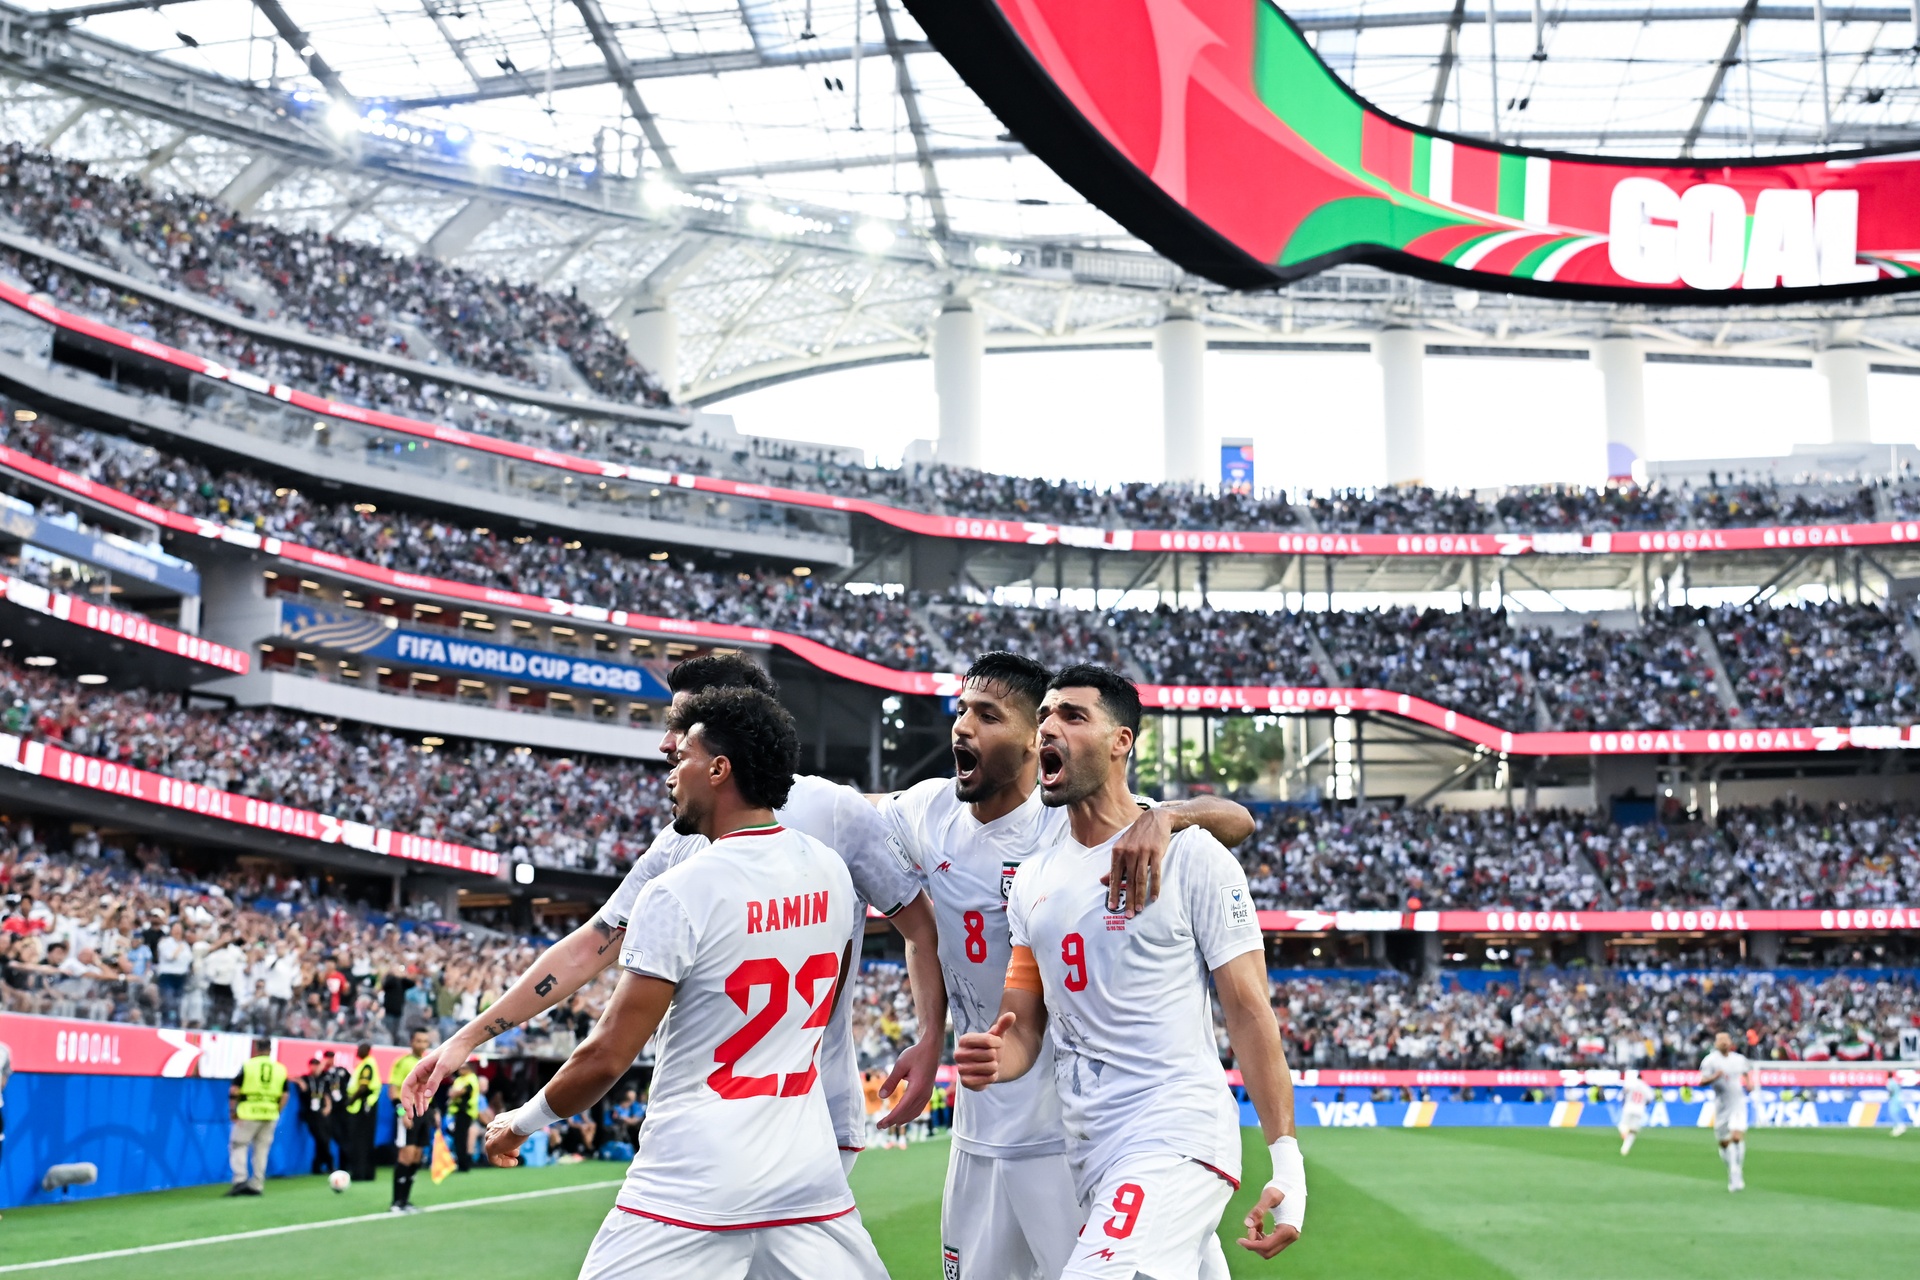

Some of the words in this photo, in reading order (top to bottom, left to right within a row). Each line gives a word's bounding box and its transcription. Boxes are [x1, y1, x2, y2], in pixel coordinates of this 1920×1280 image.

[1608, 176, 1880, 291] GOAL
[397, 634, 447, 664] FIFA
[447, 642, 526, 675] WORLD
[527, 655, 571, 681] CUP
[571, 662, 642, 692] 2026
[746, 890, 829, 935] RAMIN
[963, 910, 987, 963] 8
[1061, 932, 1088, 992] 9
[56, 1030, 121, 1064] GOOOAL
[707, 952, 840, 1100] 23
[1312, 1101, 1378, 1127] VISA
[1754, 1101, 1819, 1127] VISA
[1103, 1182, 1145, 1240] 9
